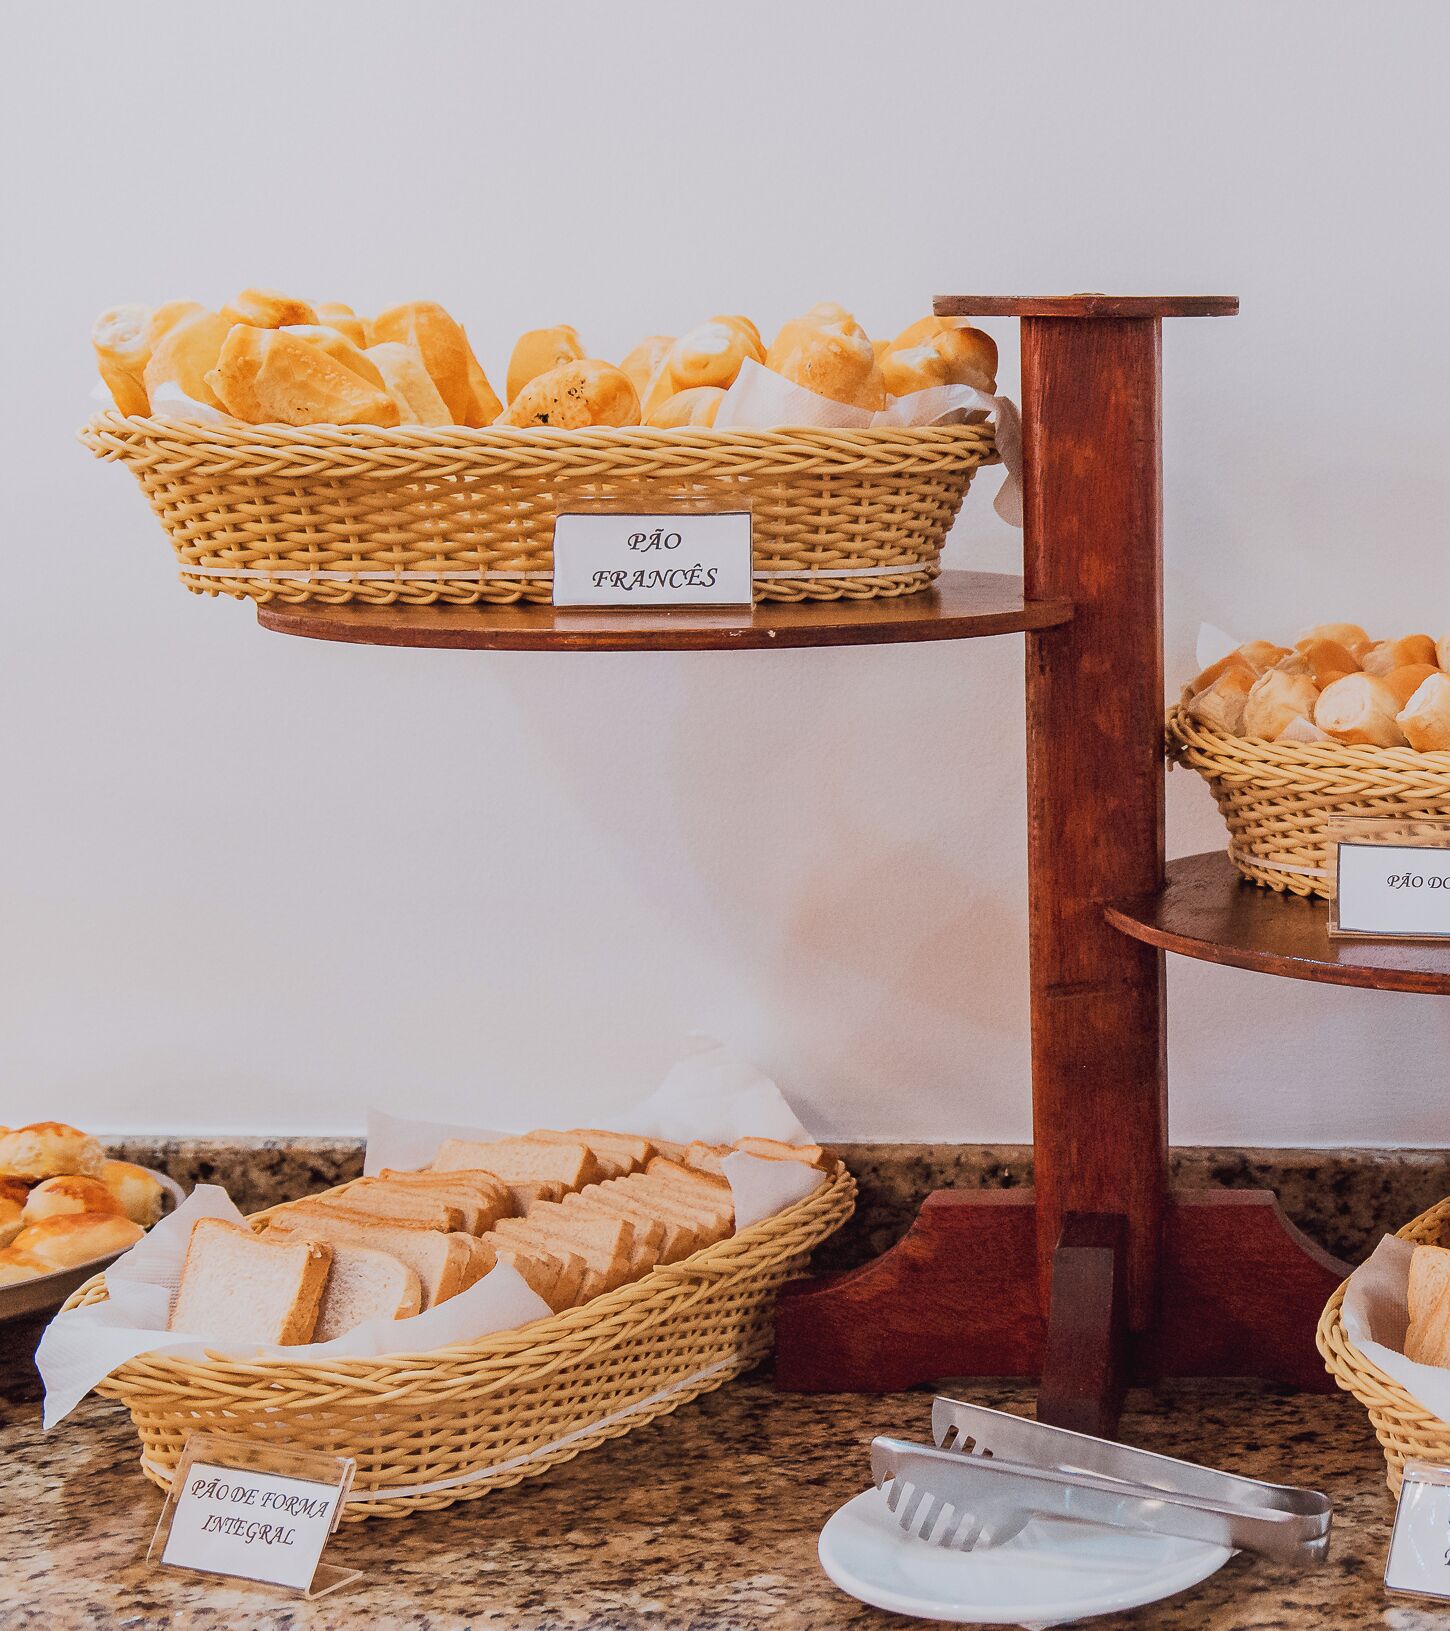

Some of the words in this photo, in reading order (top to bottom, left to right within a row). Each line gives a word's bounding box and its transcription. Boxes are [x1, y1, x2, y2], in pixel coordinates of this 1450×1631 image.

[627, 528, 682, 553] PÃO
[592, 563, 718, 591] FRANCÊS
[1386, 872, 1424, 889] PÃO
[191, 1478, 229, 1499] PÃO
[230, 1486, 260, 1506] DE
[260, 1491, 331, 1519] FORMA
[201, 1514, 296, 1545] INTEGRAL
